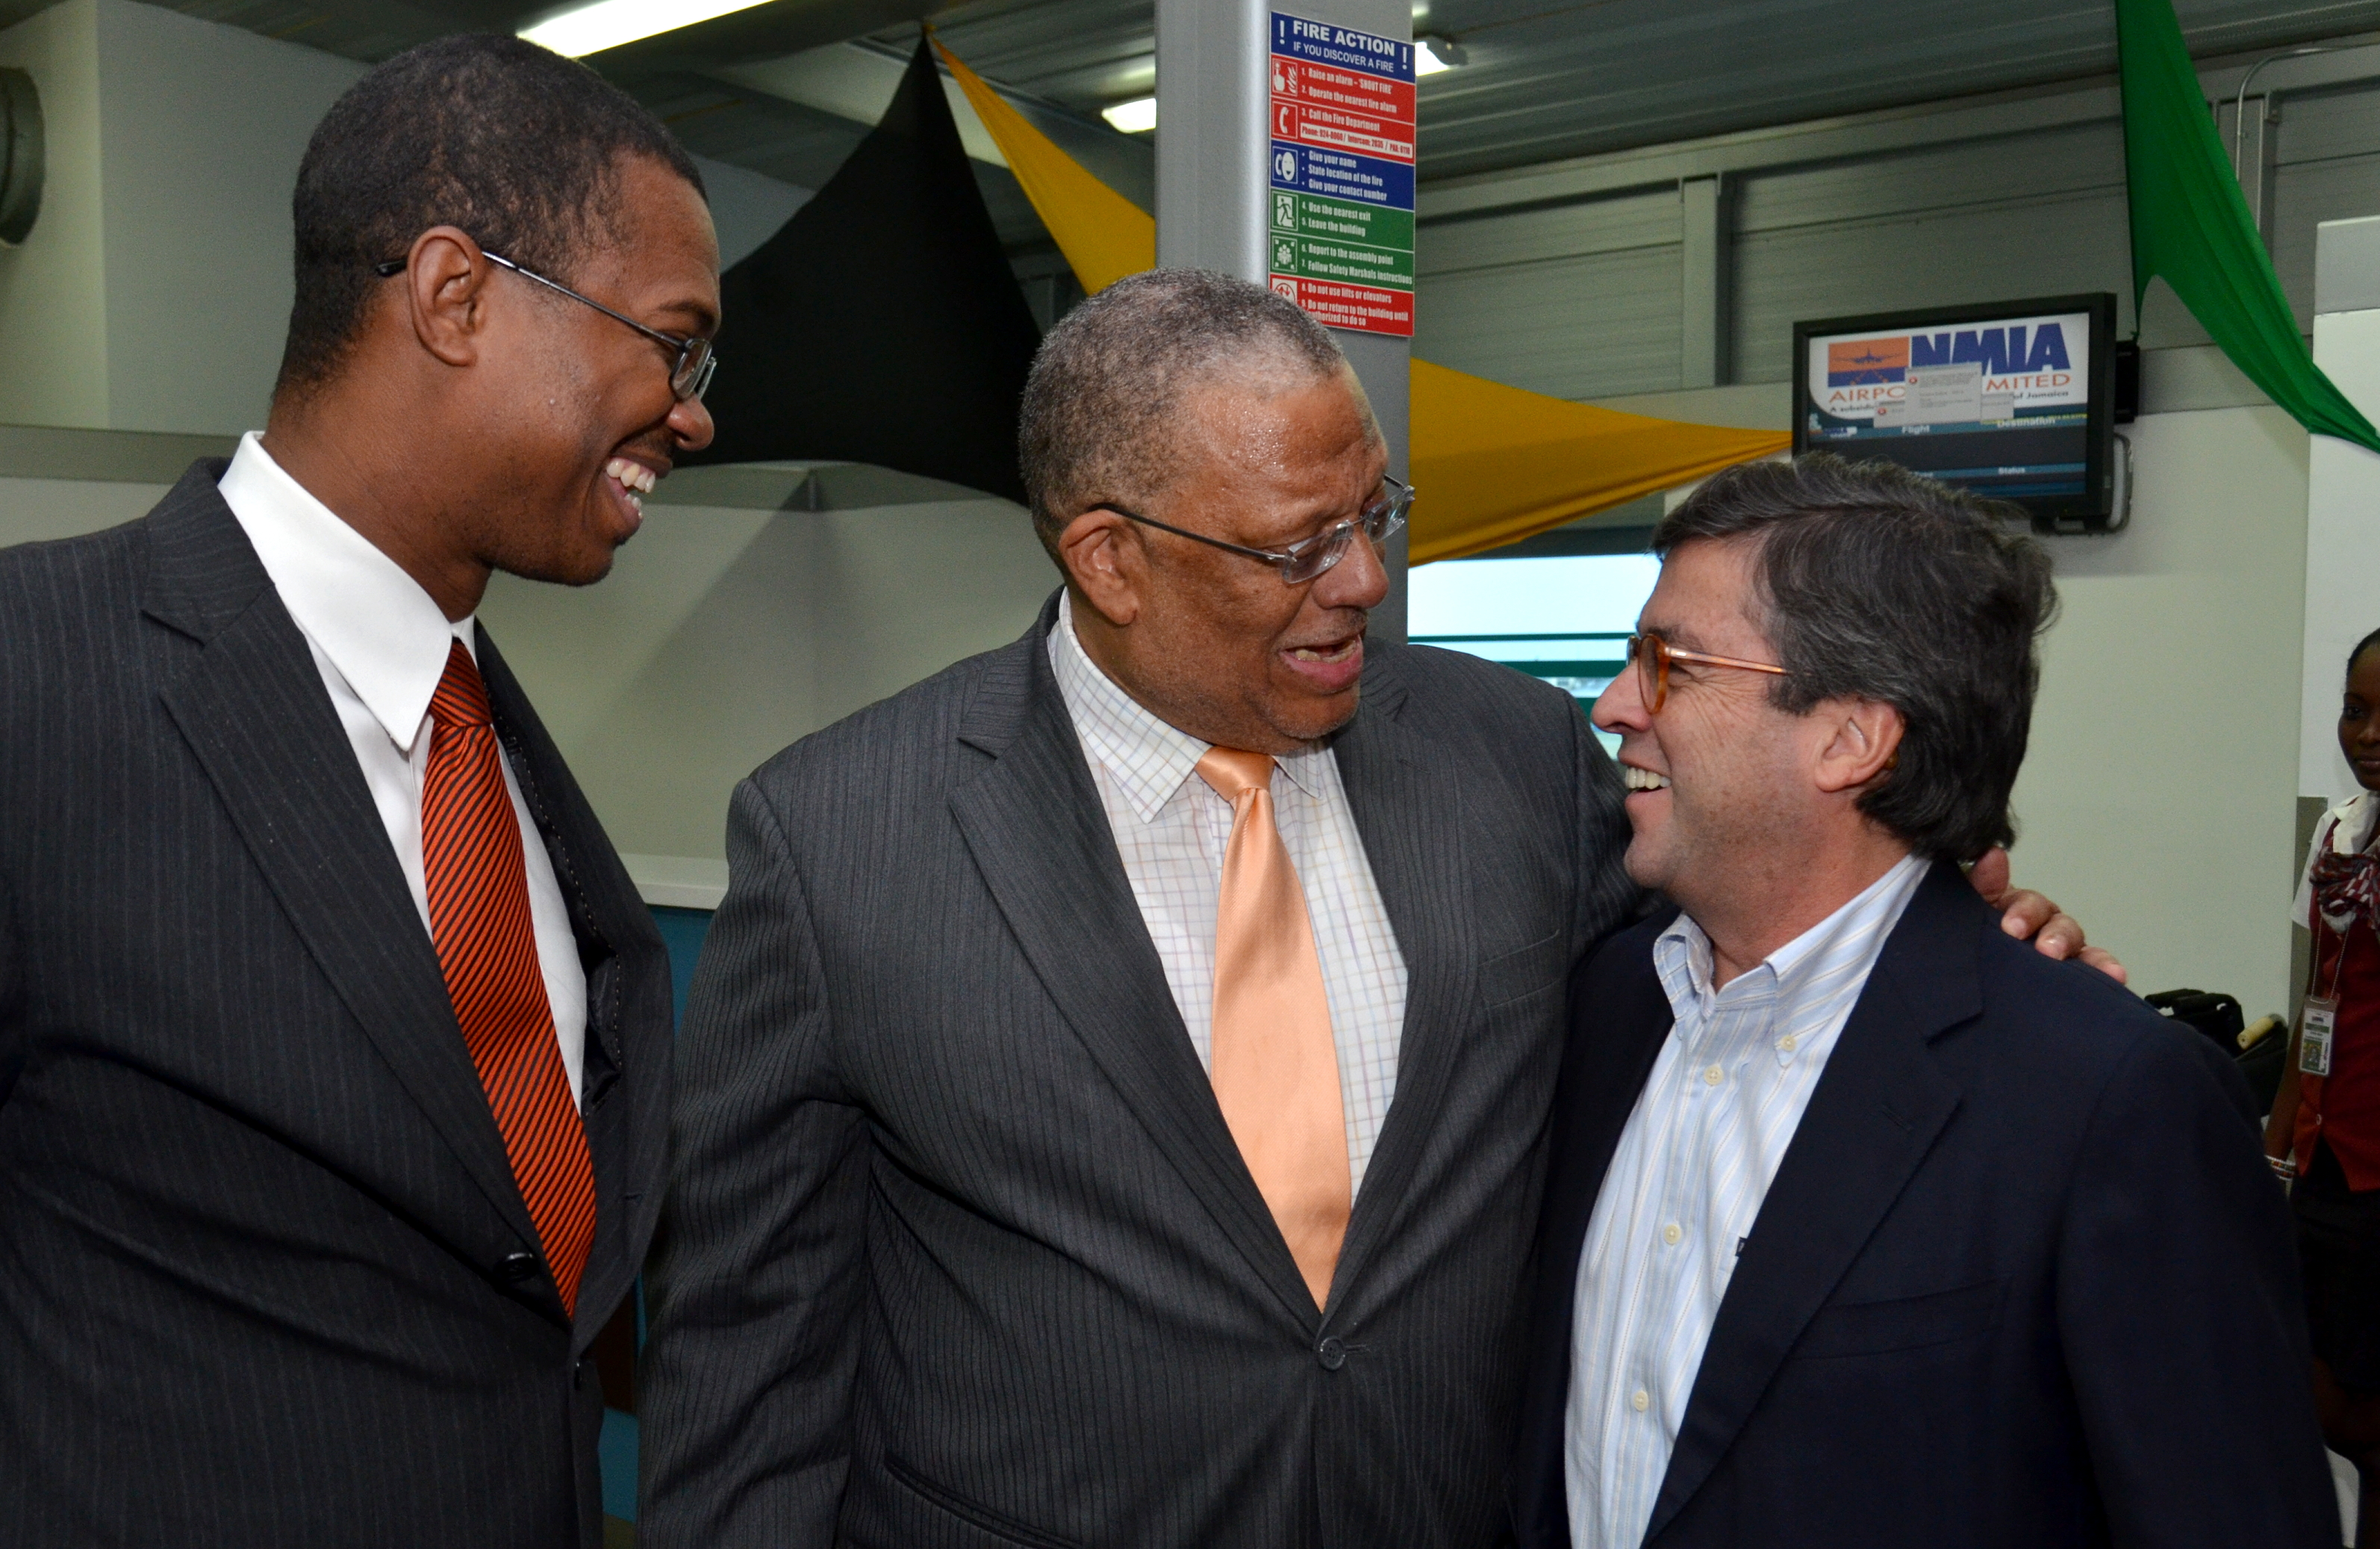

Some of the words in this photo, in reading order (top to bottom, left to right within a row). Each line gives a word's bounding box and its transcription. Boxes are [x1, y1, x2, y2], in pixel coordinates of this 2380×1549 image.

[1293, 20, 1330, 42] FIRE
[1335, 31, 1395, 57] ACTION
[1294, 42, 1301, 52] IF
[1303, 44, 1322, 57] YOU
[1324, 48, 1366, 66] DISCOVER
[1368, 59, 1374, 68] A
[1376, 60, 1394, 72] FIRE
[1309, 68, 1326, 81] Raise
[1327, 73, 1335, 82] an
[1336, 75, 1353, 87] alarm
[1302, 85, 1306, 93] 2.
[1309, 87, 1333, 100] Operate
[1334, 91, 1344, 102] the
[1345, 94, 1368, 107] nearest
[1368, 99, 1379, 110] fire
[1380, 102, 1397, 113] alarm
[1302, 107, 1306, 116] 3.
[1309, 108, 1321, 120] Call
[1322, 111, 1333, 122] the
[1333, 113, 1345, 124] Fire
[1345, 117, 1380, 132] Department
[1309, 150, 1323, 162] Give
[1324, 154, 1338, 165] your
[1339, 157, 1356, 169] name
[1309, 164, 1325, 176] State
[1326, 167, 1352, 181] location
[1353, 172, 1359, 182] of
[1360, 174, 1371, 184] the
[1372, 175, 1383, 187] fire
[1309, 178, 1323, 190] Give
[1324, 182, 1338, 193] your
[1339, 185, 1362, 197] contact
[1363, 189, 1387, 202] number
[1302, 202, 1306, 210] 4.
[1309, 202, 1321, 214] Use
[1322, 205, 1333, 215] the
[1333, 208, 1358, 219] nearest
[1359, 212, 1371, 222] exit
[1309, 218, 1327, 230] Leave
[1328, 221, 1339, 232] the
[1339, 222, 1365, 237] building
[1309, 243, 1330, 256] Report
[1330, 247, 1337, 257] to
[1338, 248, 1348, 258] the
[1348, 250, 1377, 264] assembly
[1378, 255, 1394, 265] point
[1308, 260, 1328, 272] Follow
[1329, 263, 1348, 276] Safety
[1349, 266, 1377, 279] Marshals
[1377, 270, 1412, 285] instructions
[1308, 283, 1316, 293] Do
[1317, 286, 1328, 295] not
[1329, 287, 1341, 296] use
[1342, 287, 1354, 299] lifts
[1355, 290, 1362, 299] or
[1363, 291, 1392, 304] elevators
[1308, 299, 1316, 309] Do
[1317, 302, 1328, 311] not
[1329, 303, 1349, 314] return
[1350, 305, 1356, 314] to
[1357, 306, 1368, 316] the
[1368, 307, 1393, 320] building
[1395, 311, 1408, 321] until
[1342, 314, 1348, 324] to
[1349, 315, 1357, 325] do
[1359, 318, 1366, 326] so
[1911, 322, 2071, 376] NMIA
[1986, 373, 2071, 391] MITED
[2027, 391, 2069, 399] Jamaica
[1902, 425, 1930, 435] Flight
[1997, 417, 2056, 428] Destination
